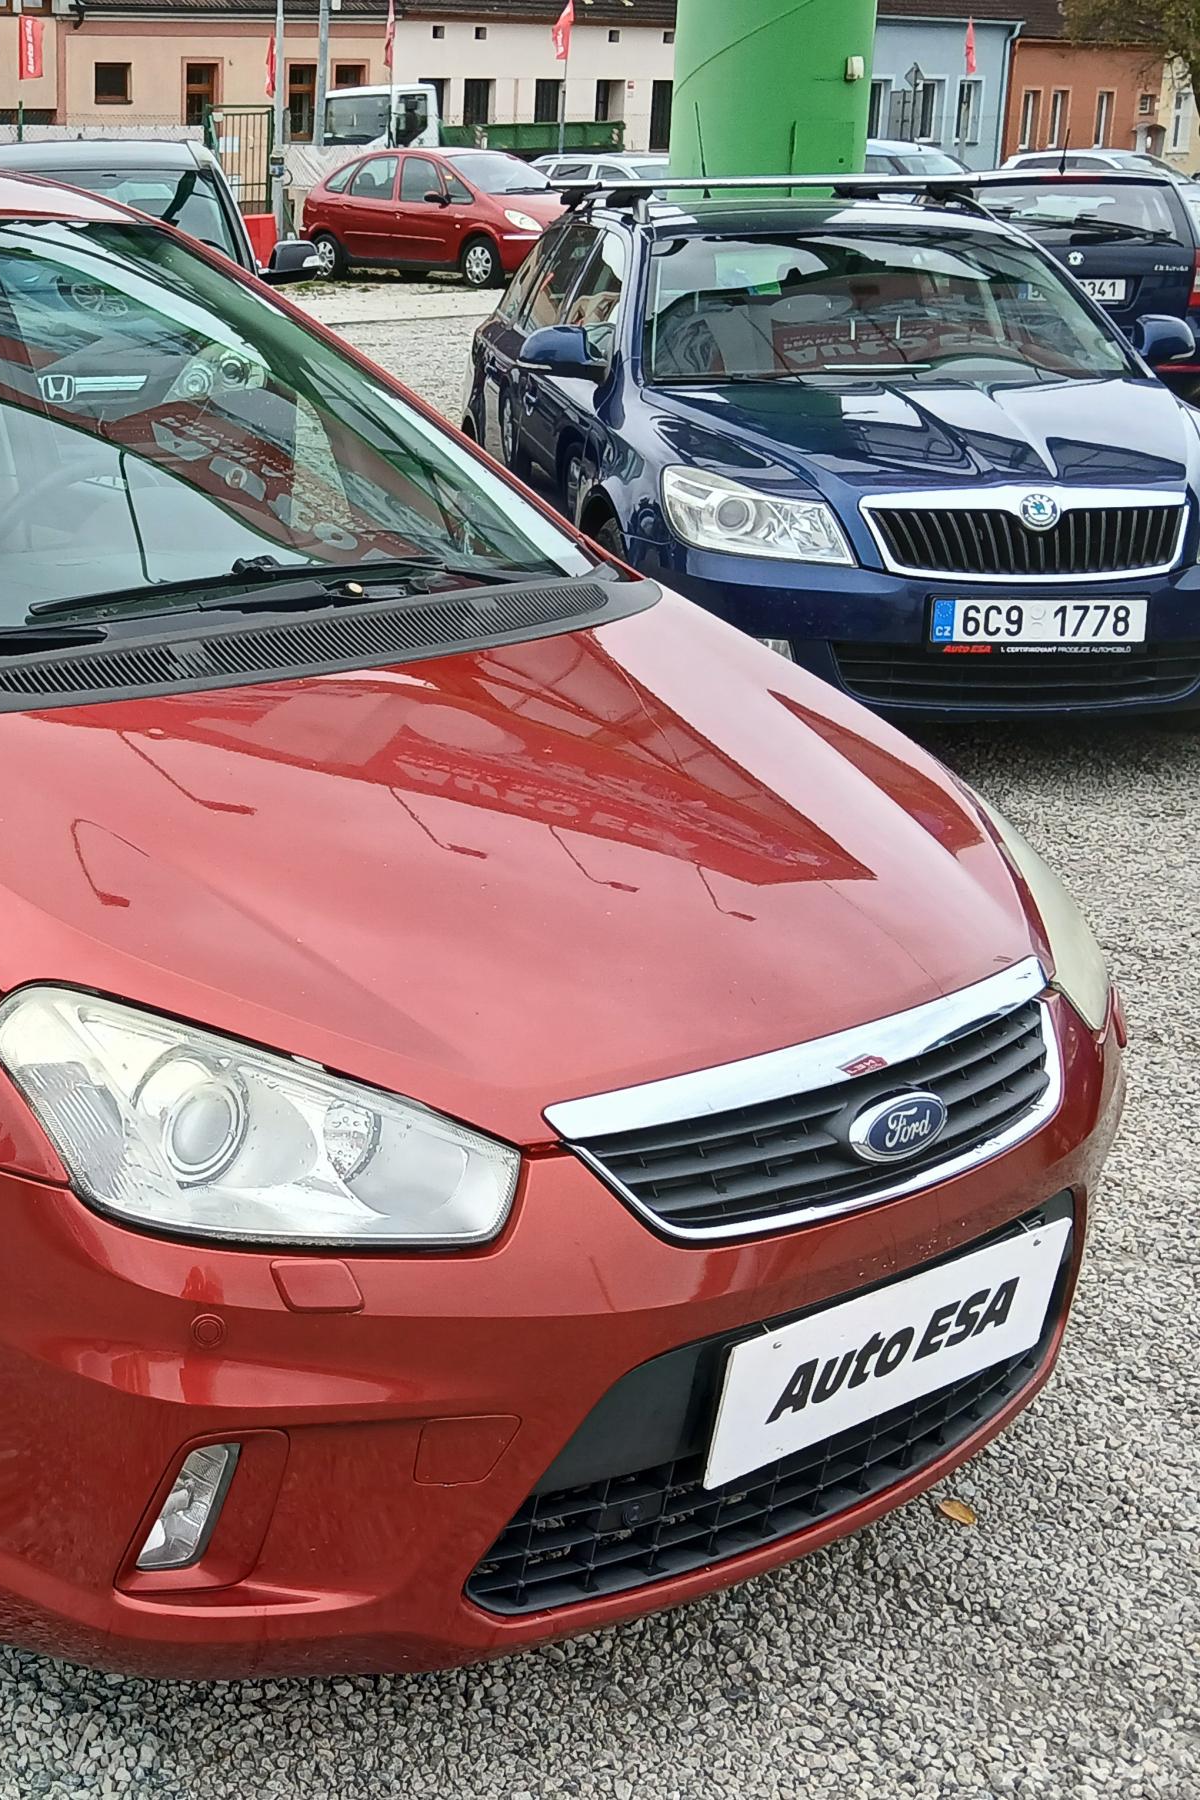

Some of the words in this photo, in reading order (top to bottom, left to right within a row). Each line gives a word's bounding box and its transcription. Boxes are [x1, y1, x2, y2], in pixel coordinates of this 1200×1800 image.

[935, 625, 951, 637] CZ
[962, 604, 1024, 637] 6C9
[1053, 604, 1131, 637] 1778
[885, 1106, 931, 1148] Ford
[764, 1326, 916, 1425] Auto
[911, 1276, 1020, 1362] ESA
